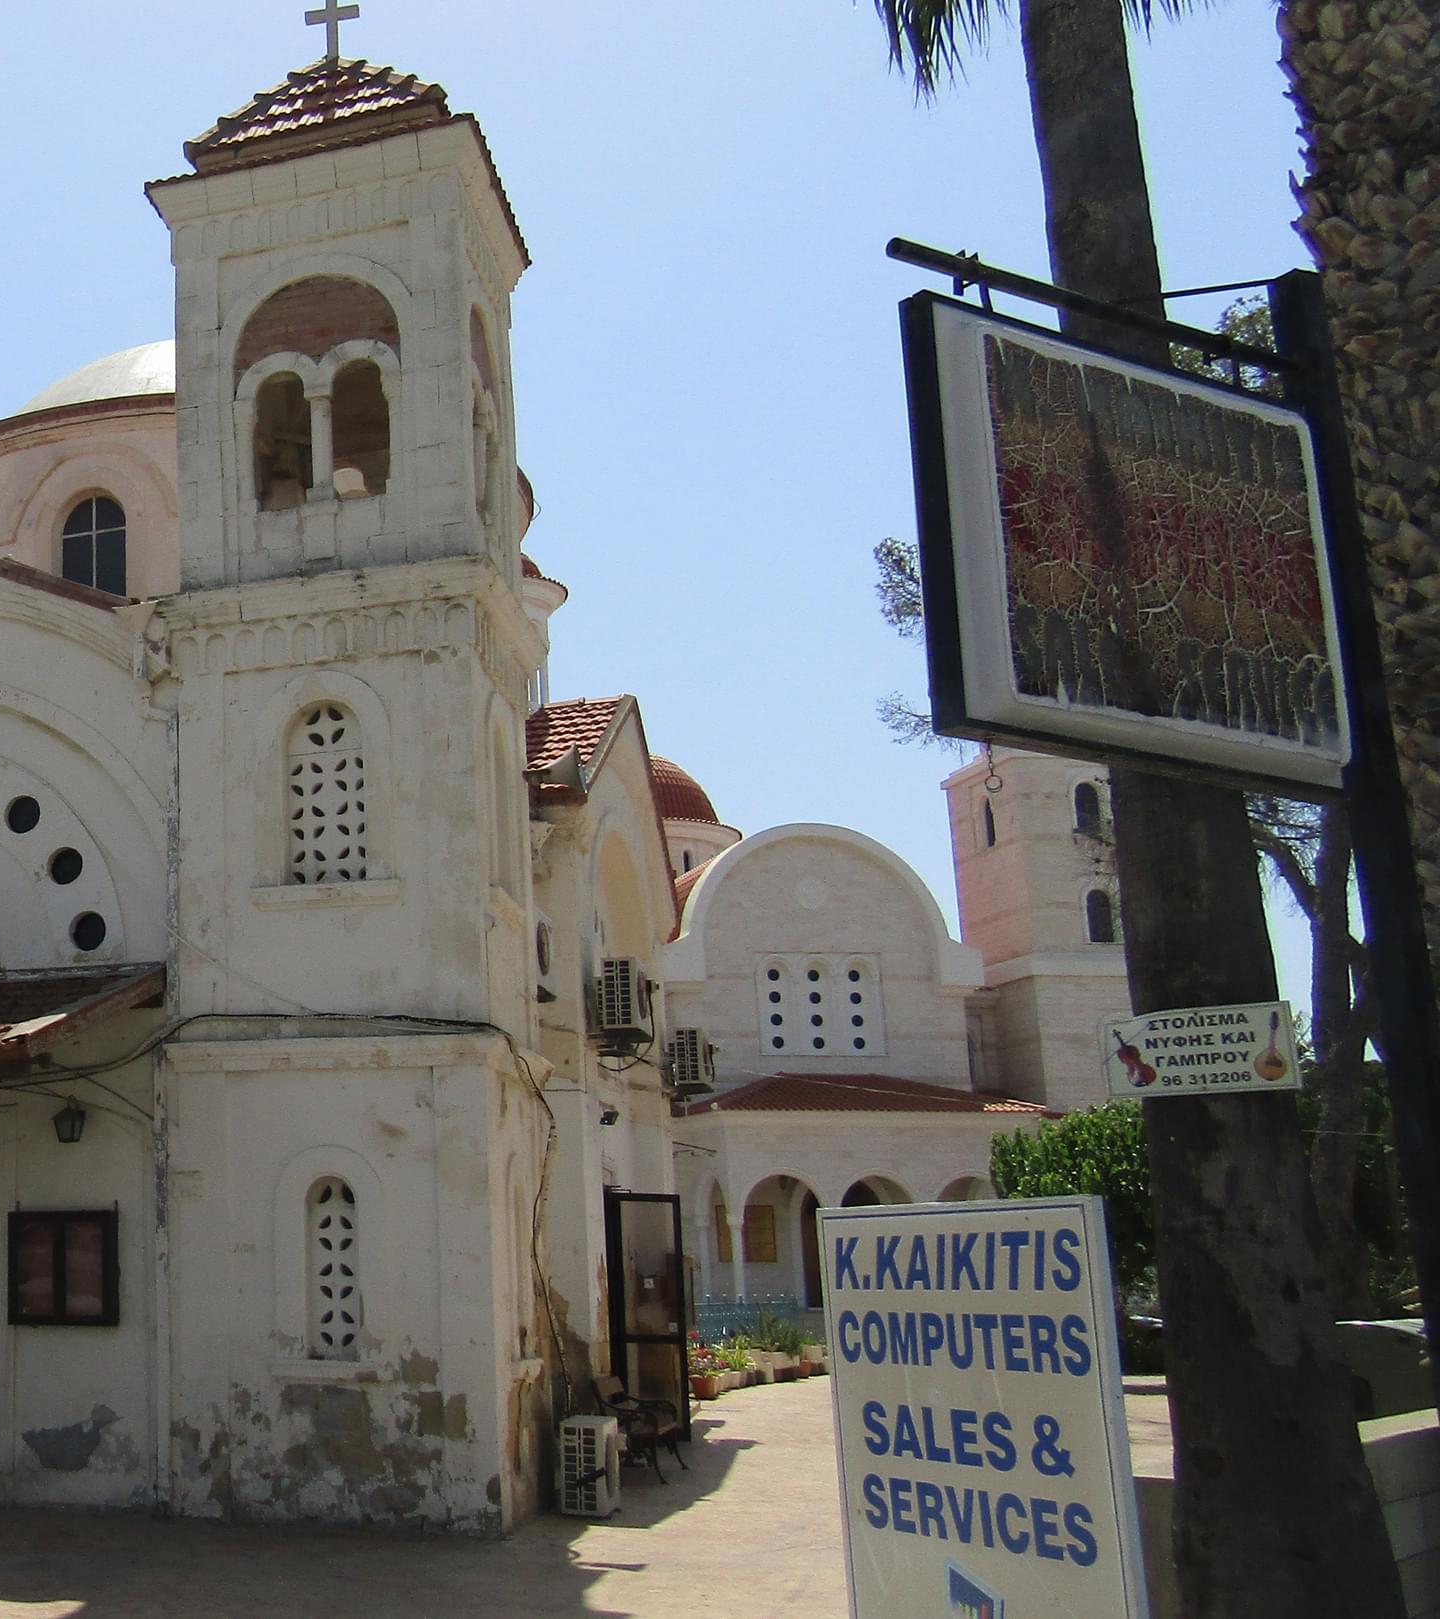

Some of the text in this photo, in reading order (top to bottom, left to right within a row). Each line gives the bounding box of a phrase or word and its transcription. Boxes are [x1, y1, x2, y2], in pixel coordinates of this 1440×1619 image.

[1145, 1031, 1256, 1049] ΝΥΦΗΣ ΚΑΙ
[1155, 1051, 1250, 1067] ΓΑΜΠΡΟΥ
[1161, 1071, 1252, 1087] 96 312206
[835, 1228, 1082, 1292] K.KAIKITIS
[838, 1310, 1092, 1377] COMPUTERS
[862, 1400, 1076, 1478] SALES &
[862, 1472, 1098, 1567] SERVICES
